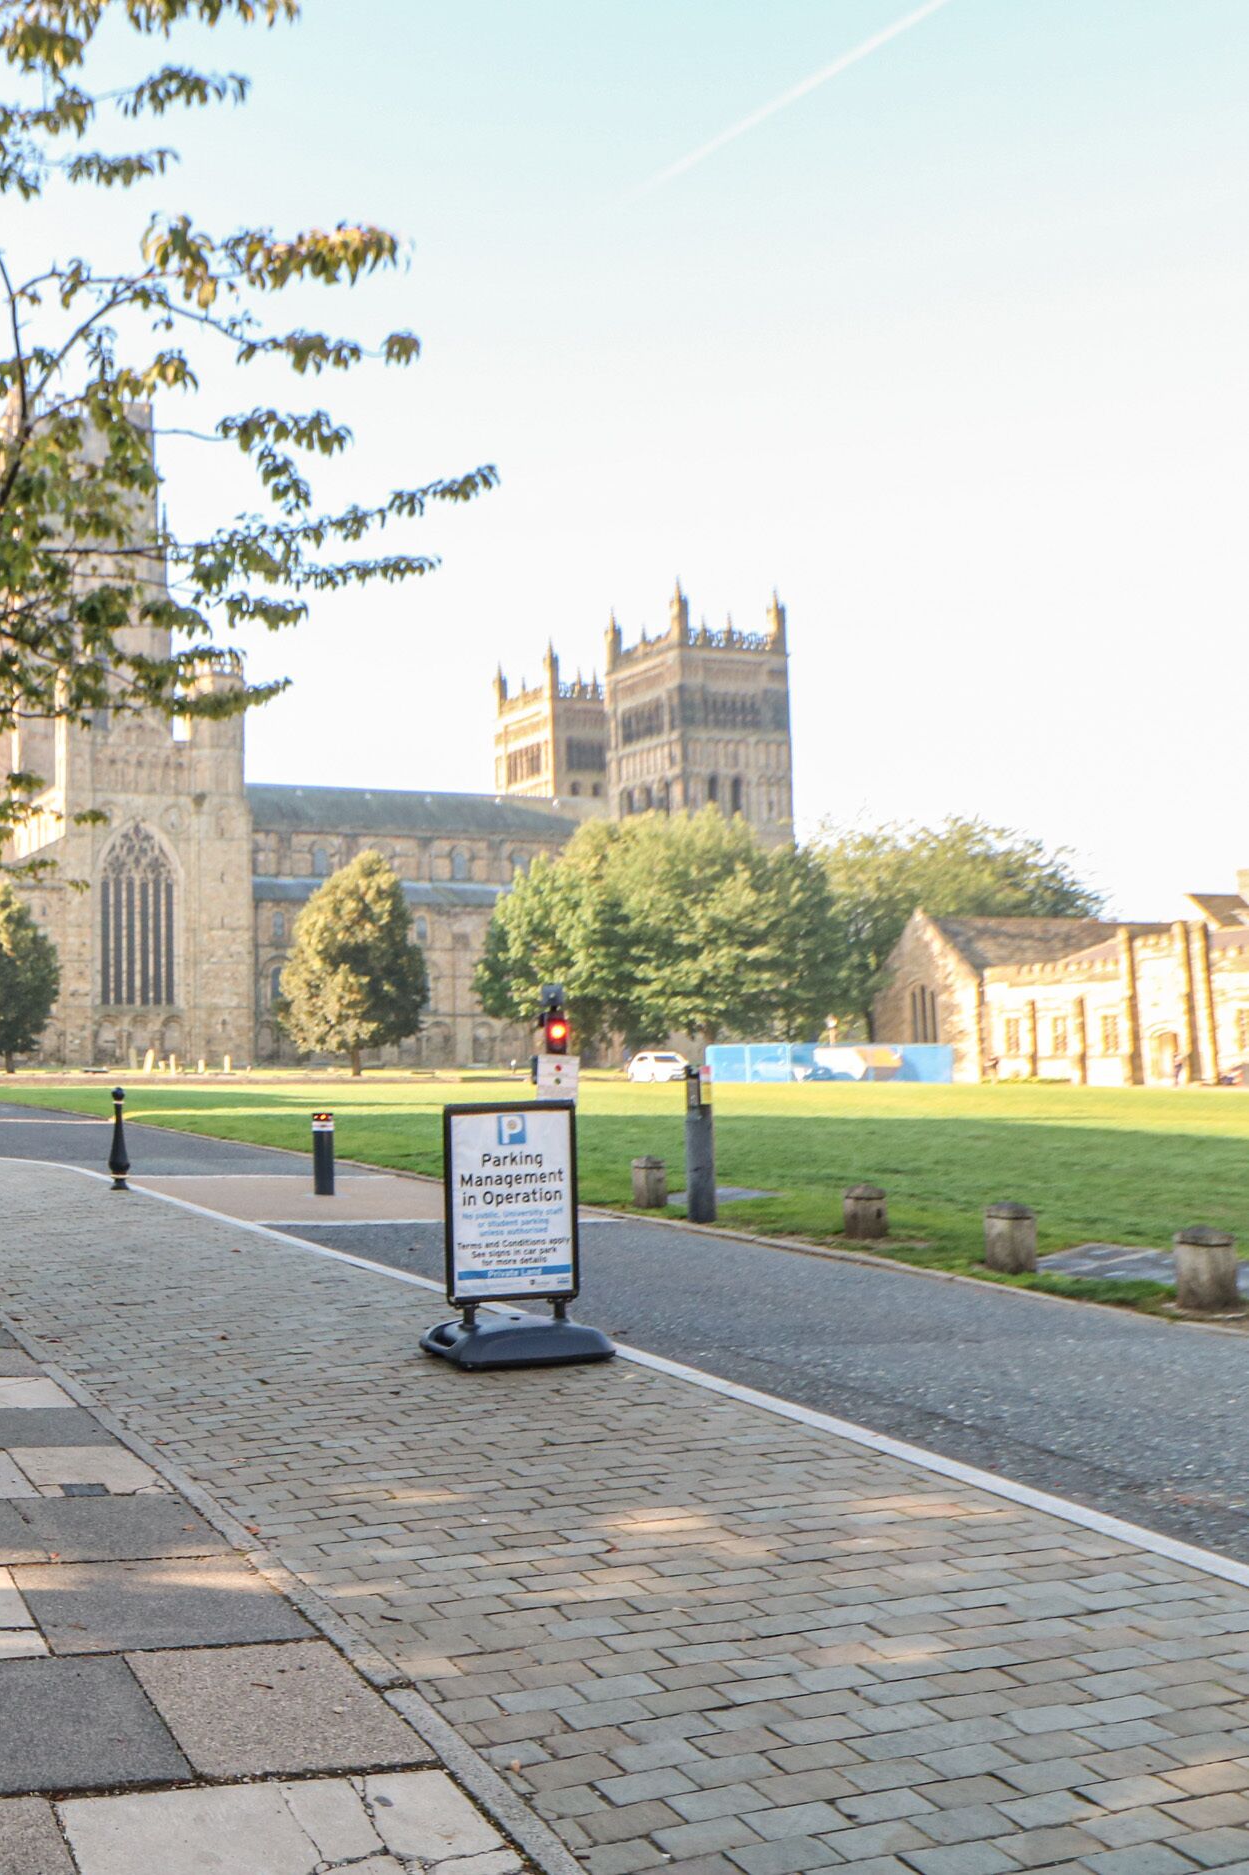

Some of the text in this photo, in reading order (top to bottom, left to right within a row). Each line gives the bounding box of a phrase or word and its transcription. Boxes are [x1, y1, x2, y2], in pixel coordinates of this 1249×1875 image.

[481, 1151, 543, 1167] Parking
[460, 1168, 564, 1188] Management
[462, 1187, 563, 1207] in Operation
[457, 1236, 571, 1251] Terms and Conditions apply
[471, 1246, 557, 1259] See signs in car park
[481, 1255, 547, 1267] for more details
[487, 1267, 543, 1279] Private Land
